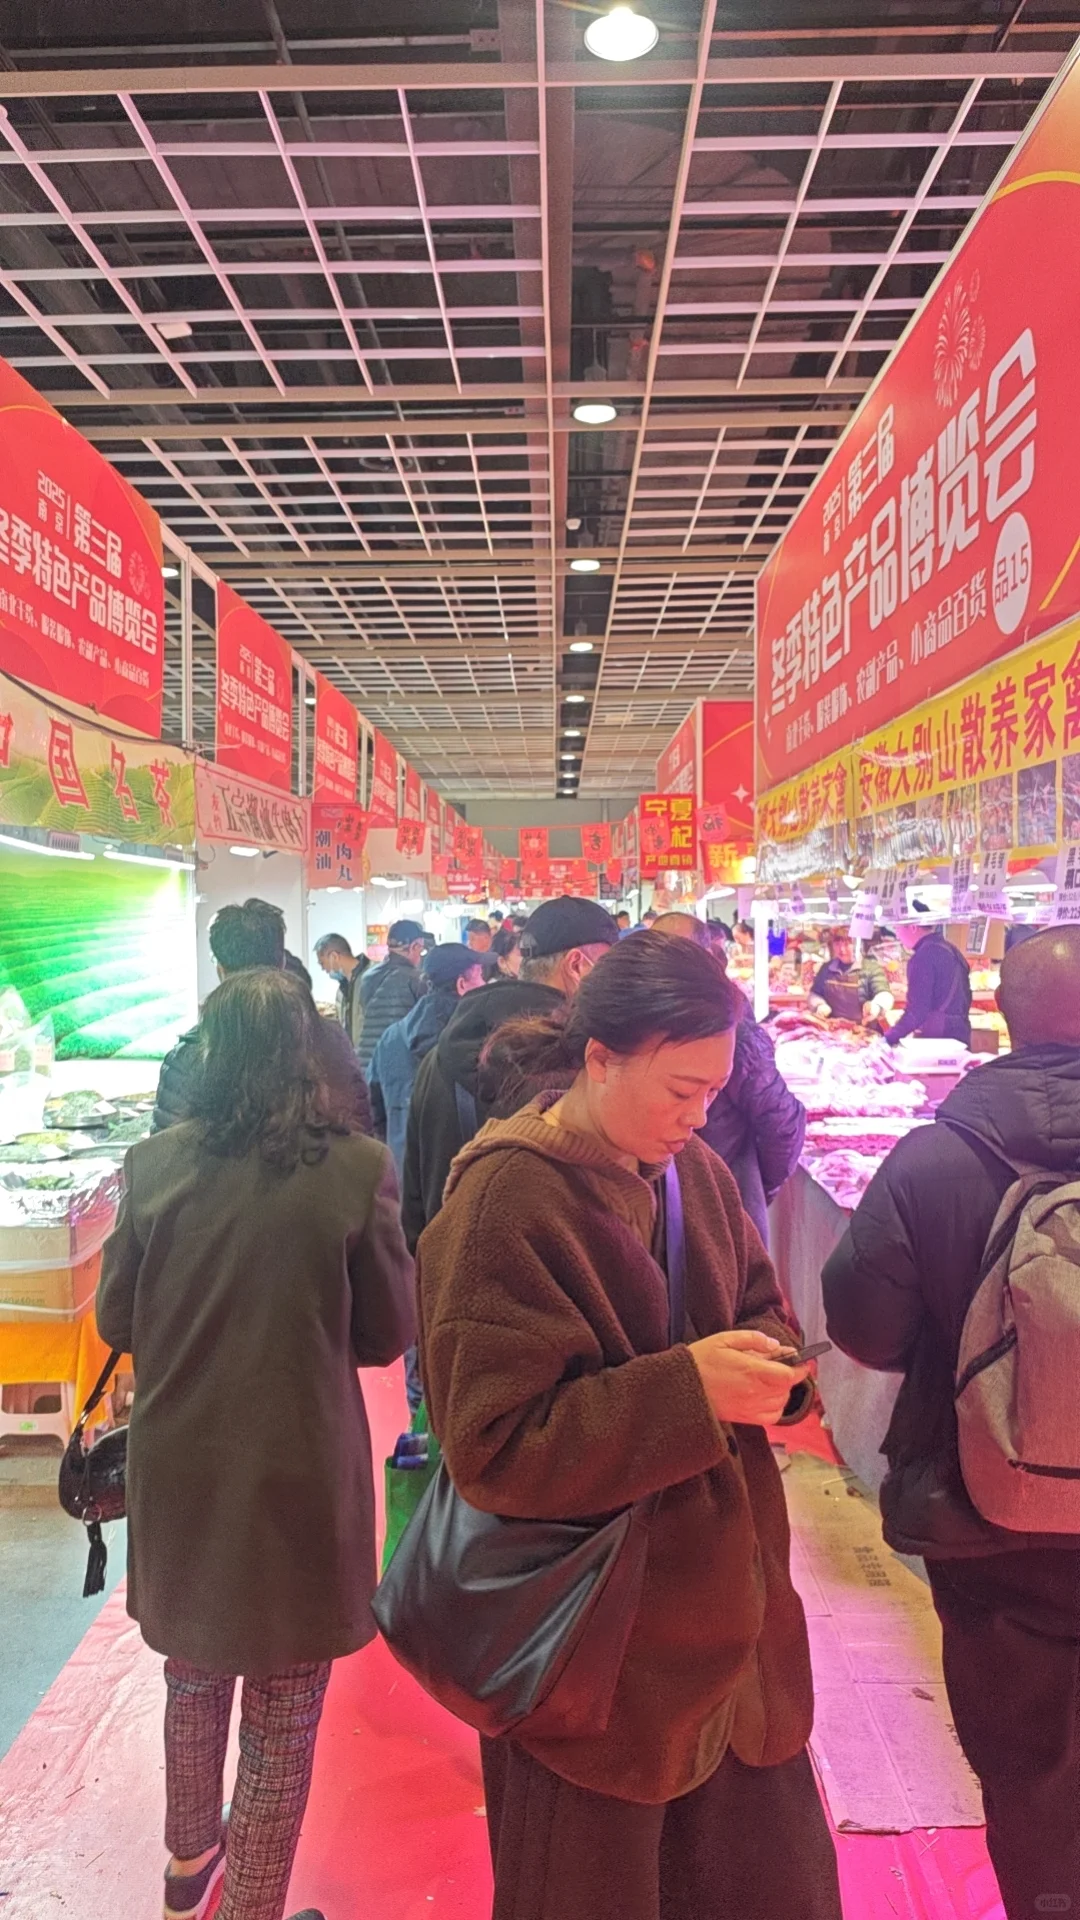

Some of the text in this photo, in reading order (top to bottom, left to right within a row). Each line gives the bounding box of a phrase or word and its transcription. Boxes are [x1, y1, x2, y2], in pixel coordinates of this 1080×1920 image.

[37, 469, 65, 510] 2025
[847, 403, 894, 525] 第三届
[73, 502, 122, 579] 第三届
[772, 327, 1037, 716] 冬季特色产品博览会
[645, 798, 692, 821] 宁夏
